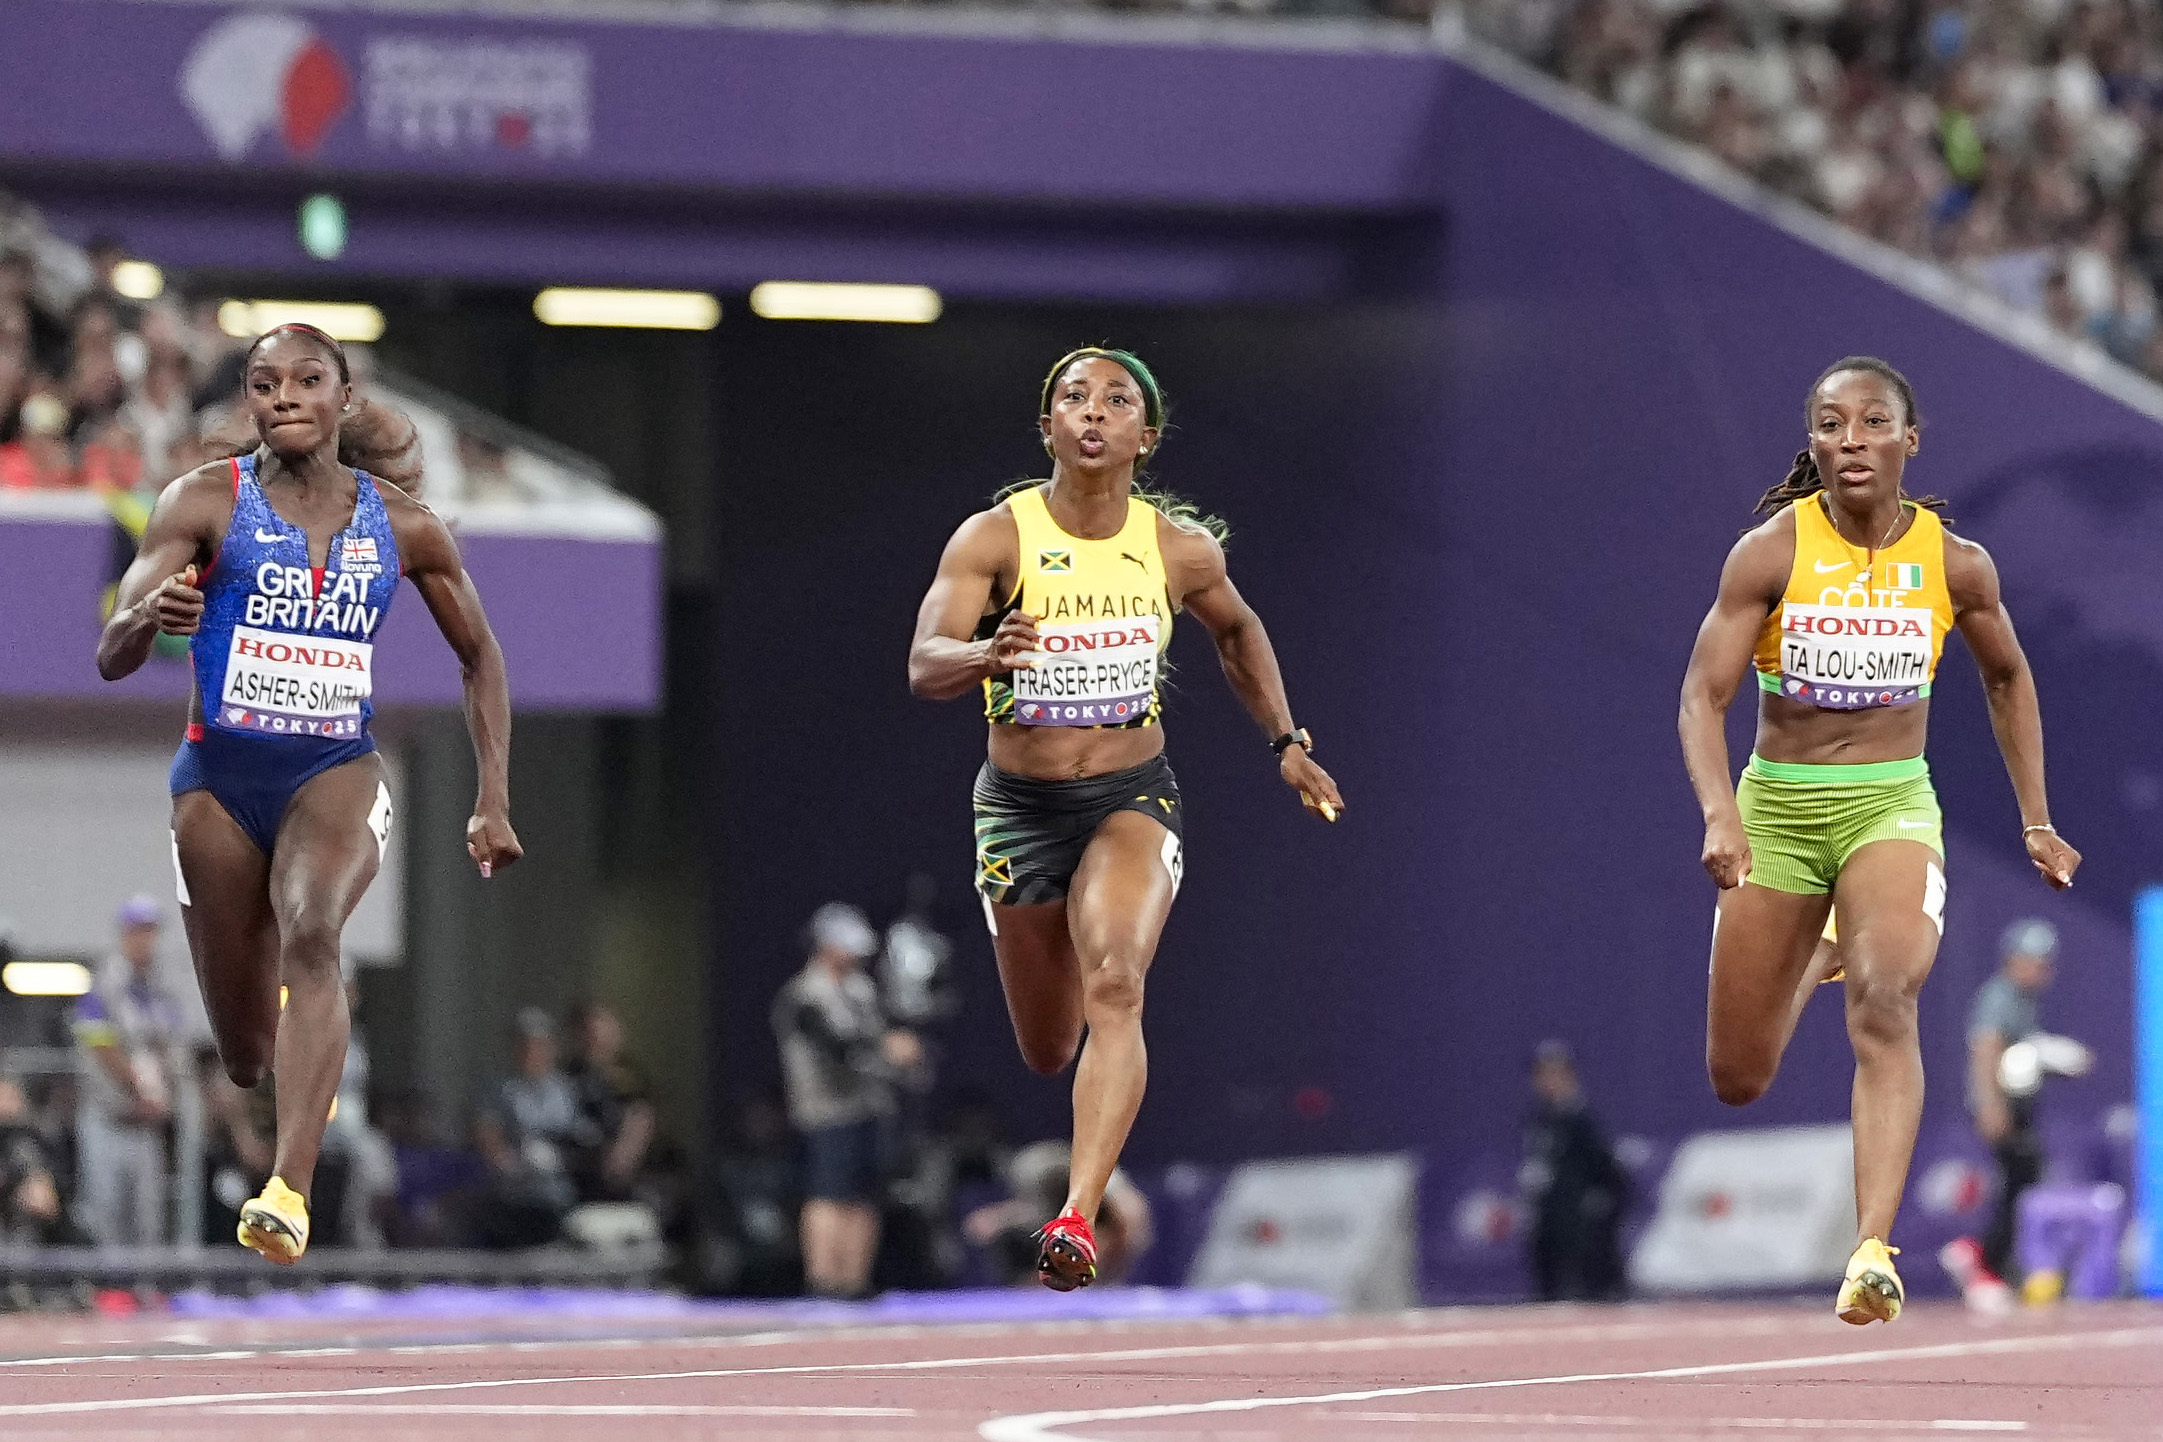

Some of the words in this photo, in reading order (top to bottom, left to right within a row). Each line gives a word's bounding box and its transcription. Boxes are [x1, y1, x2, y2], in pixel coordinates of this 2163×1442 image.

[257, 562, 374, 604] GREAT
[245, 595, 378, 634] BRITAIN
[1041, 594, 1163, 621] JAMAICA
[1034, 627, 1154, 653] ONDA
[1787, 615, 1926, 637] HONDA
[235, 636, 366, 672] HONDA
[1788, 643, 1809, 677] TA
[1815, 648, 1926, 681] LOU-SMITH
[1019, 658, 1151, 695] FRASER-PRYCE
